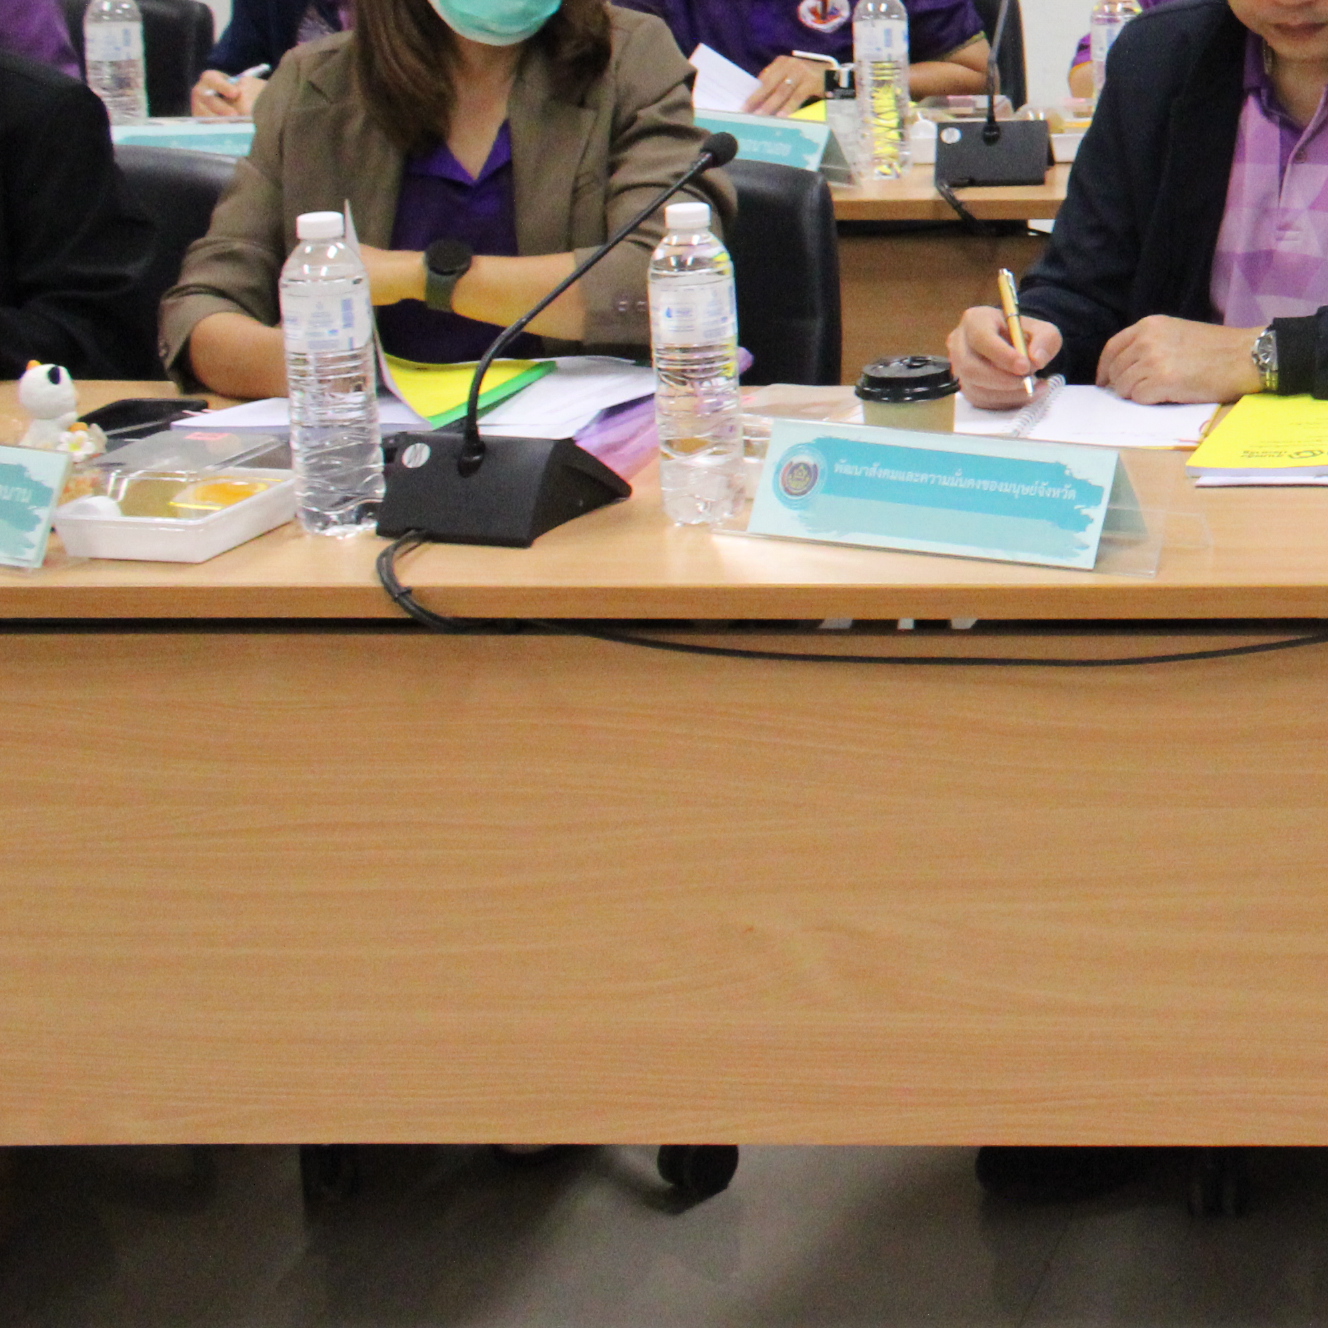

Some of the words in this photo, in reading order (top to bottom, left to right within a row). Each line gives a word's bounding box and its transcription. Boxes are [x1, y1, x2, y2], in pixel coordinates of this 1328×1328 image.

[833, 457, 1077, 501] พัฒนาสังคมและความมั่นคงของมนุษย์จังหวัด
